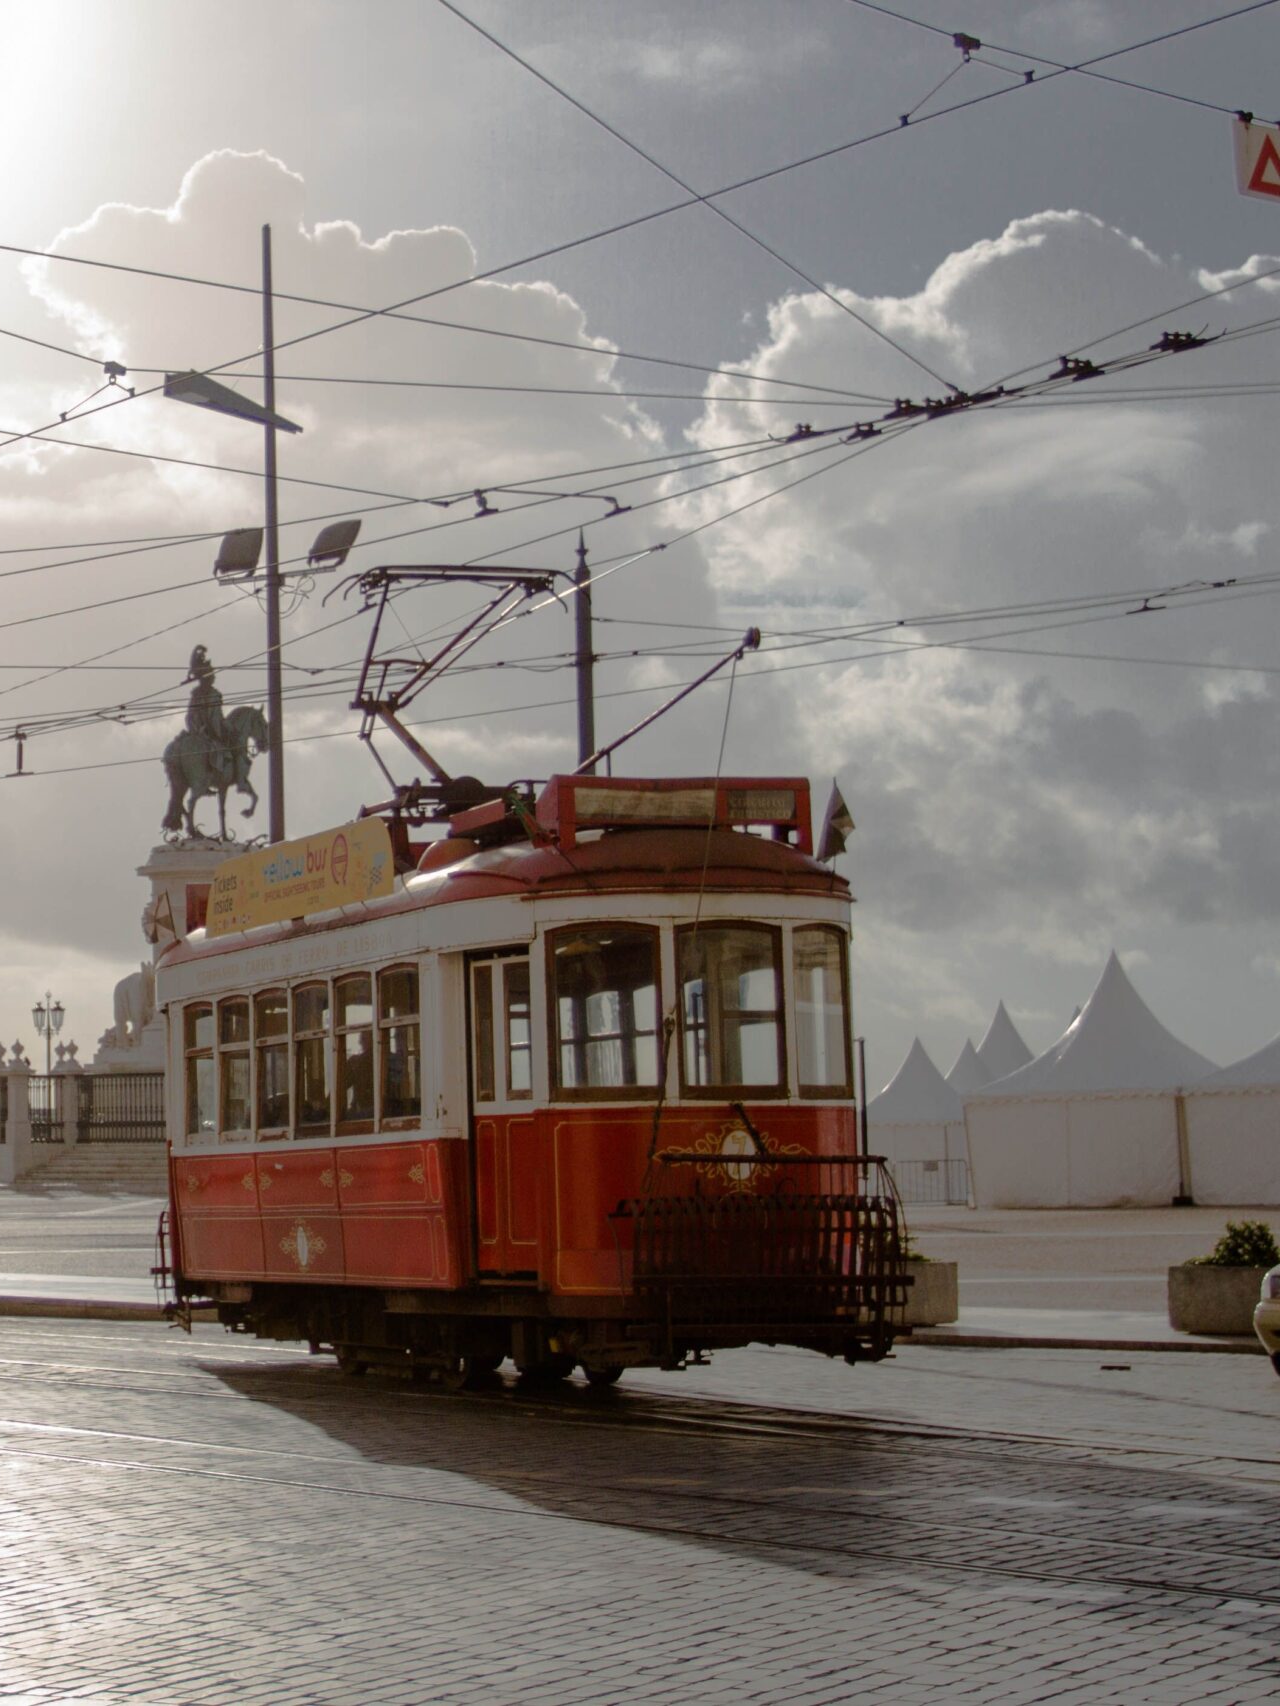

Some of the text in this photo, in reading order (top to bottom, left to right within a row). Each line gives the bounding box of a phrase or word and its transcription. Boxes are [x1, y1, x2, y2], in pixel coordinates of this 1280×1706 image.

[306, 843, 327, 874] bus
[214, 873, 237, 895] Tickets
[337, 940, 348, 957] DE
[354, 930, 392, 953] LISBOA
